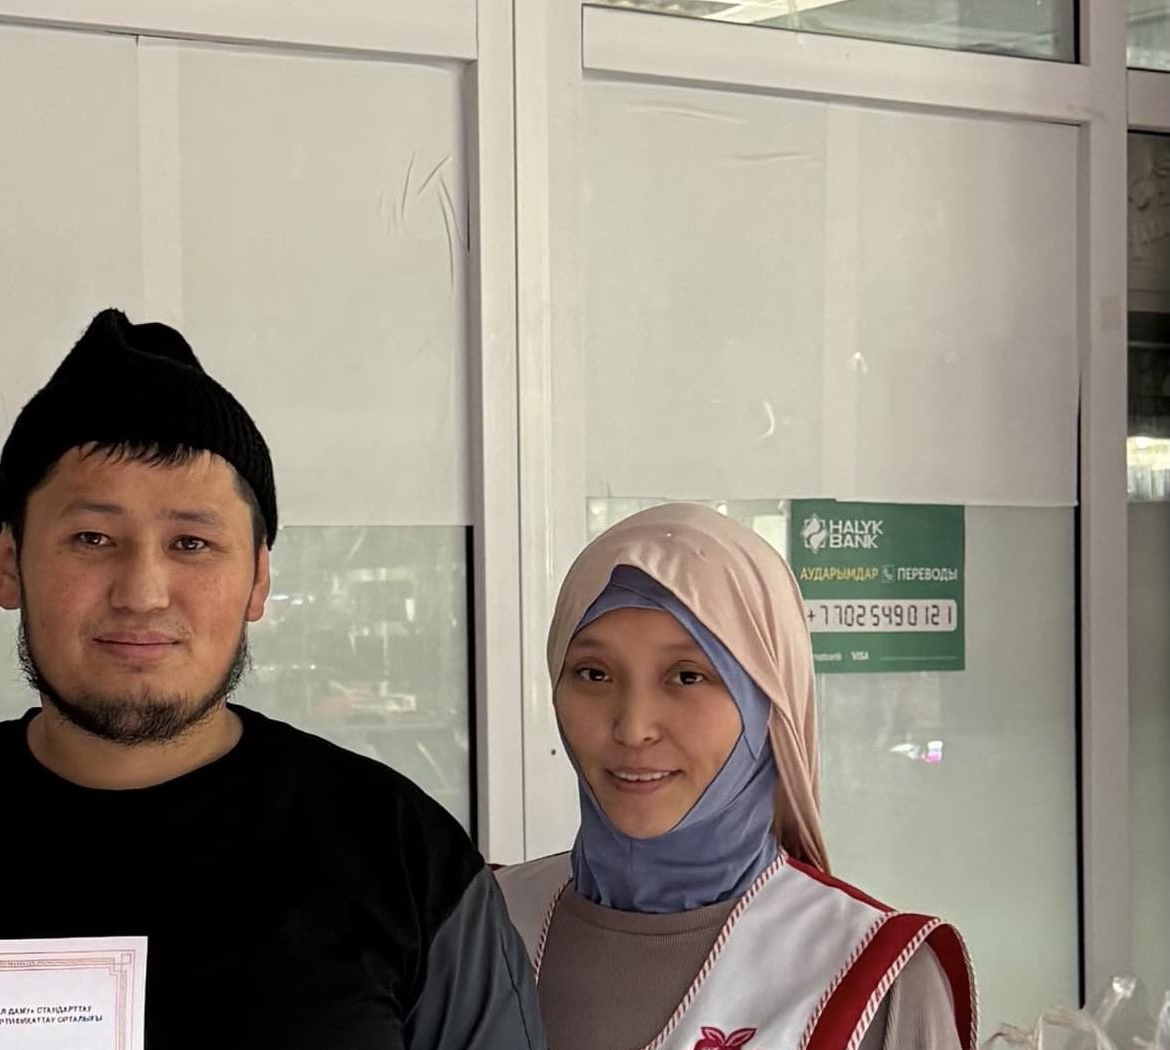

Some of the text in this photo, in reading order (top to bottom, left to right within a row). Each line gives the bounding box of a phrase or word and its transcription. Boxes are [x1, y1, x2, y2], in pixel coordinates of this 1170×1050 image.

[830, 520, 883, 535] HALYK
[830, 535, 878, 549] BANK
[800, 567, 958, 582] АУДАРЫМДАР ПЕРЕВОДЫ
